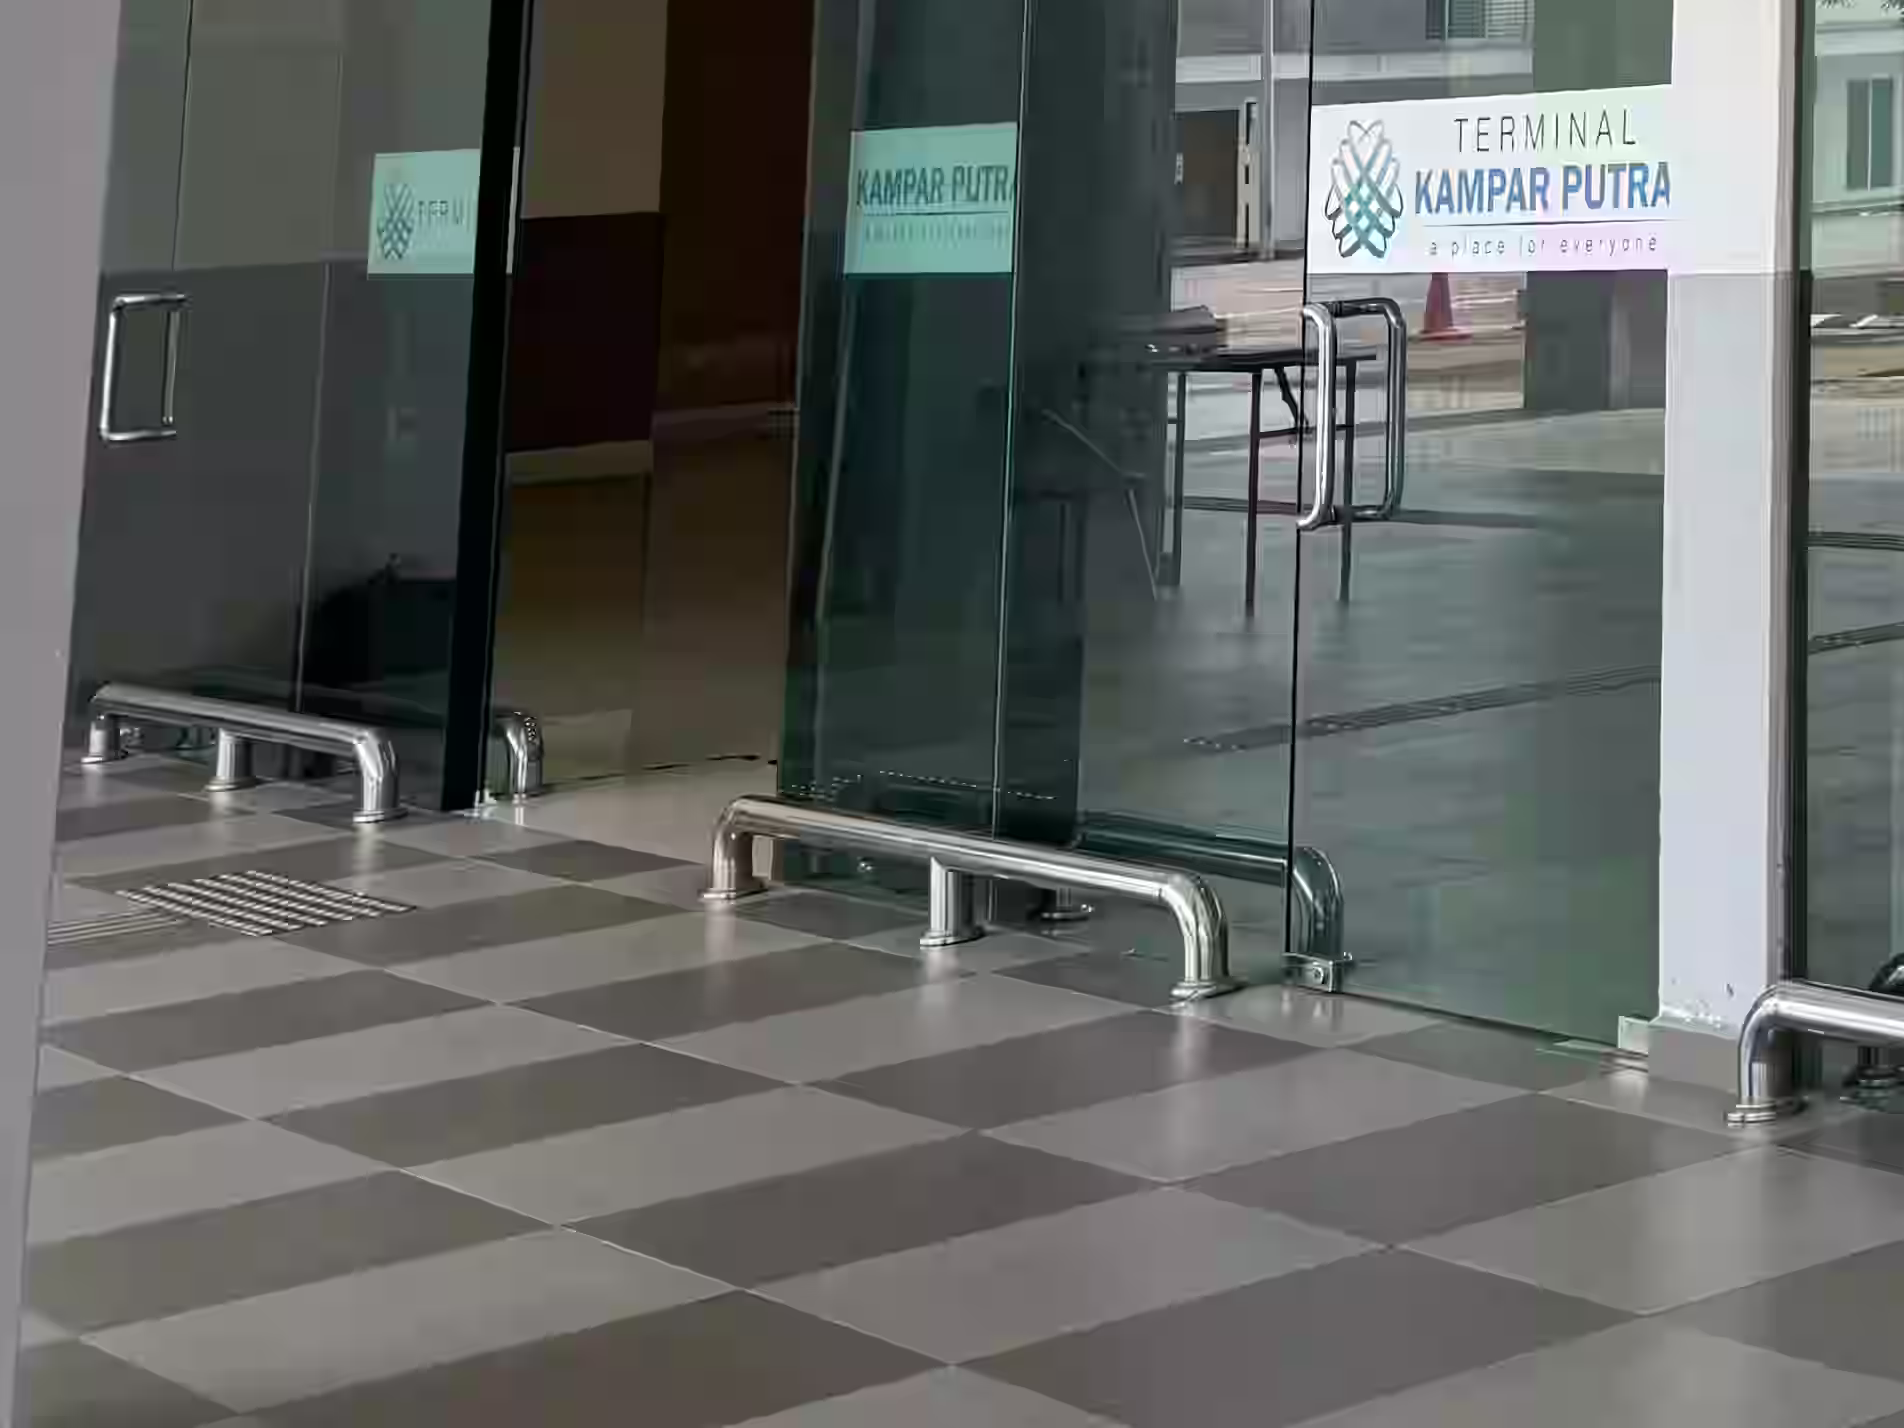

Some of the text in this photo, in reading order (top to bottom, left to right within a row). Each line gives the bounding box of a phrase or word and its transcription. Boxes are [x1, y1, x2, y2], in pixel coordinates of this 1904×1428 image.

[1453, 107, 1637, 153] TERMINAL
[857, 164, 1015, 207] KAMPAR PUTR
[1415, 160, 1672, 215] KAMPAR PUTRA
[1450, 236, 1506, 259] place
[1559, 234, 1659, 259] everyone
